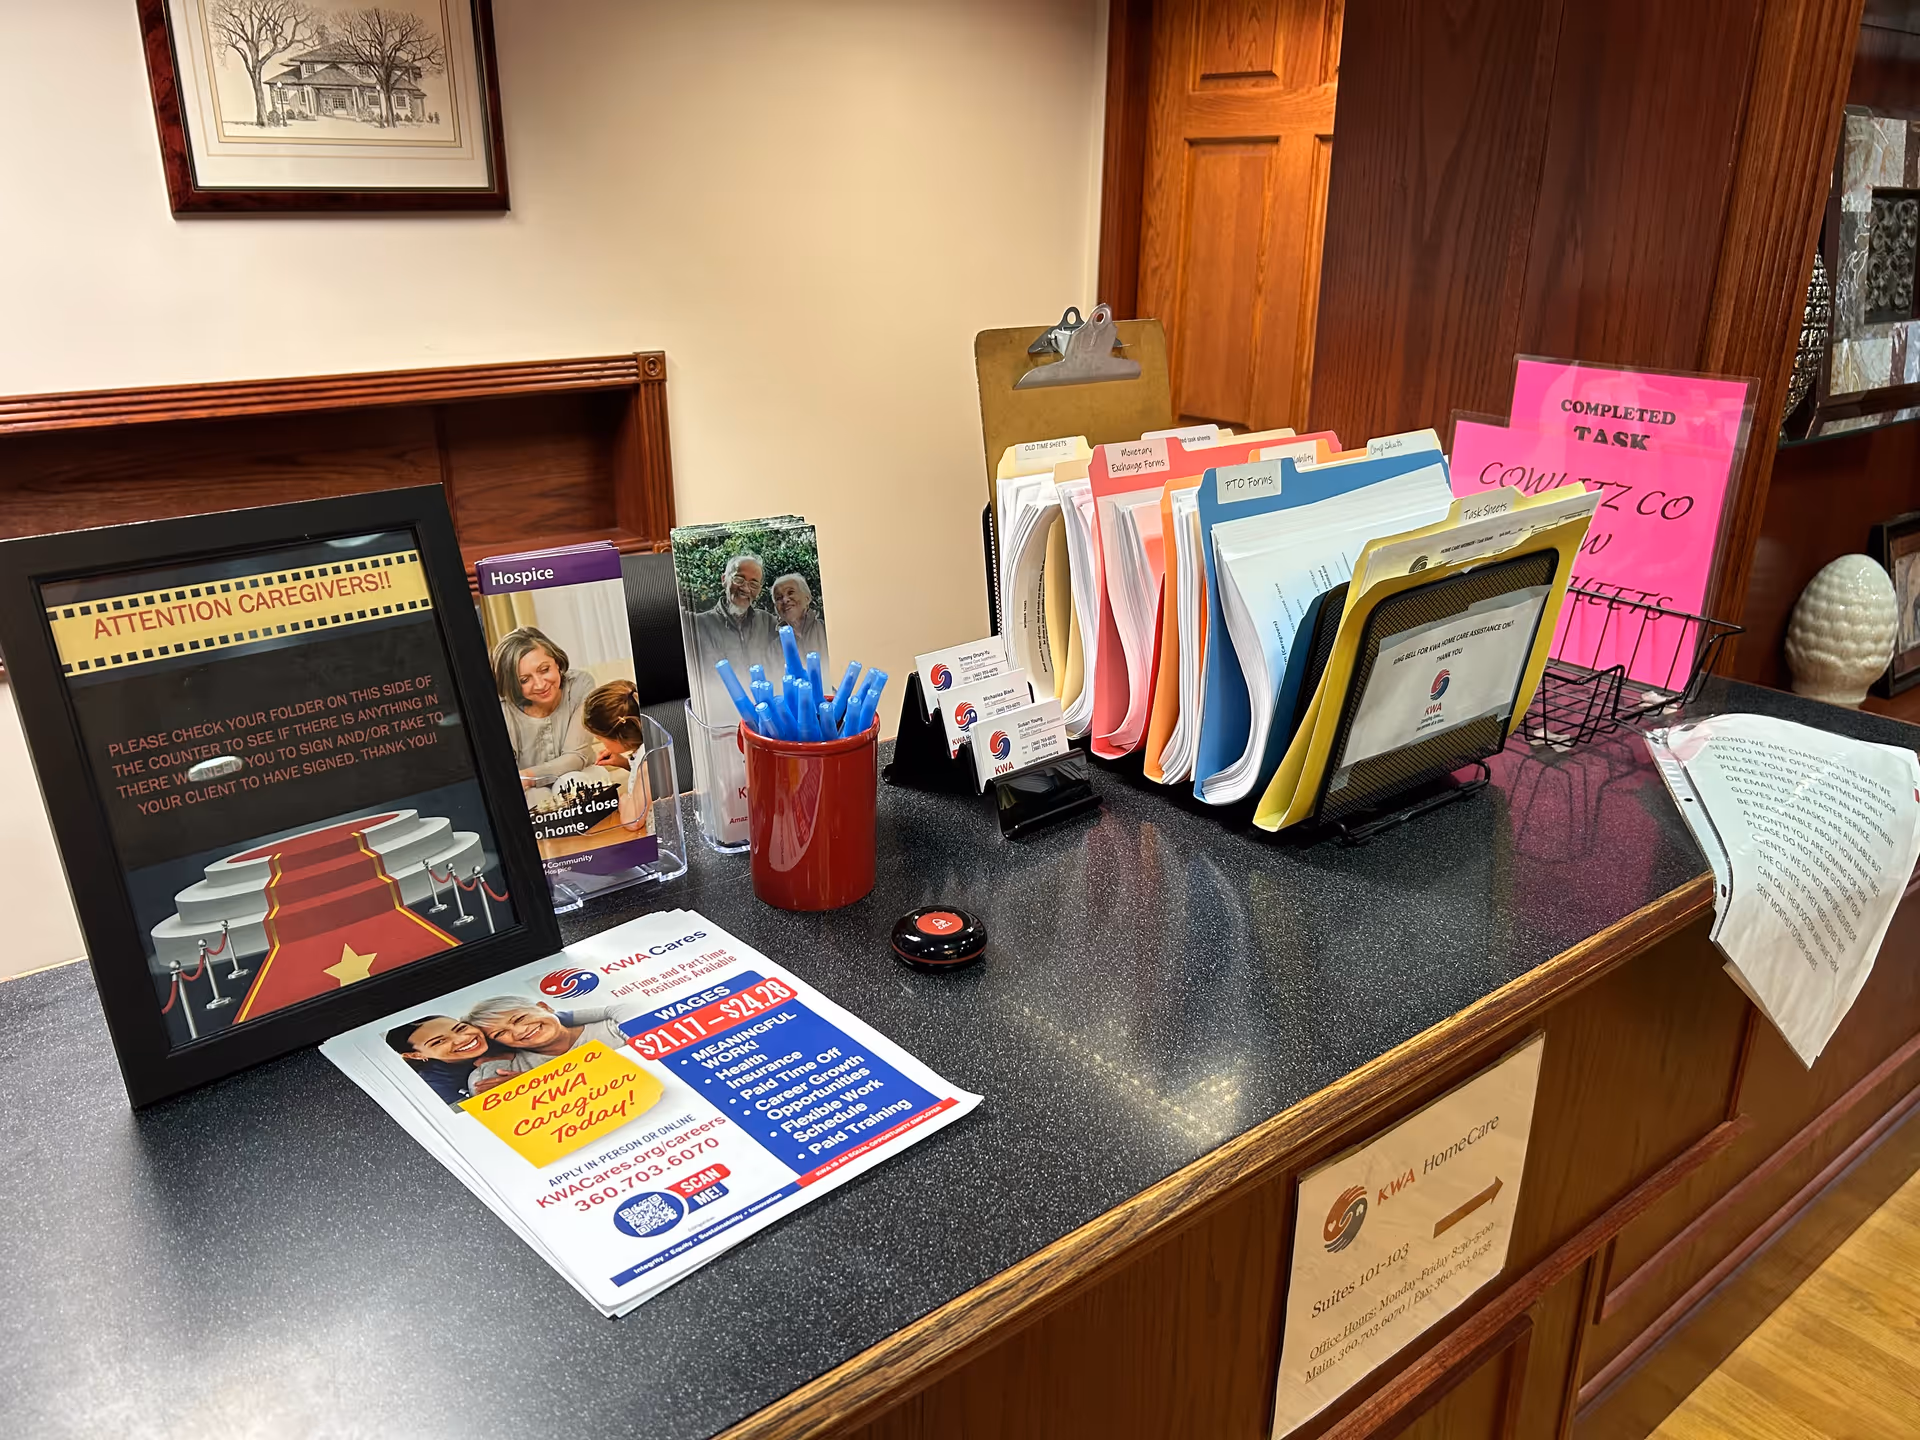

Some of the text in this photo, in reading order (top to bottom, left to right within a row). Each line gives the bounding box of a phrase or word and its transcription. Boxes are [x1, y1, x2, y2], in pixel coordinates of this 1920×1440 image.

[1560, 399, 1677, 425] COMPLETED
[1037, 442, 1049, 450] TIME
[1049, 440, 1067, 448] SHEETS
[1121, 446, 1153, 457] Monetary
[1573, 425, 1651, 451] TASK
[1111, 459, 1165, 473] Exchange Forms
[1225, 474, 1273, 492] PTO Forms
[1479, 462, 1694, 520] COWTZ CO
[1463, 501, 1508, 521] Task Sheets
[491, 566, 554, 586] Hospice
[1569, 575, 1673, 621] HEETS
[93, 571, 392, 640] ATTENTION CAREGIVERS!!
[1405, 651, 1416, 659] BELL
[1417, 646, 1429, 656] FOR
[1429, 643, 1441, 652] KWA
[1441, 636, 1456, 647] HOME
[1456, 631, 1469, 641] CARE
[1469, 624, 1500, 637] ASSISTANCE
[1451, 647, 1463, 656] YOU
[107, 674, 432, 757] PLEASE CHECK YOUR FOLDER ON THIS SIDE OF
[1425, 702, 1442, 716] KWA
[112, 693, 437, 778] THE COUNTER TO SEE IF THERE IS ANYTHING IN
[116, 774, 170, 799] THERE
[202, 760, 243, 778] NEED
[244, 750, 275, 768] YOU
[277, 745, 297, 760] TO
[299, 736, 333, 755] SIGN
[336, 723, 389, 748] AND/OR
[391, 715, 424, 733] TAKE
[426, 710, 443, 725] TO
[137, 731, 437, 816] YOUR CLIENT TO HAVE SIGNED. THANK YOU!
[995, 763, 1014, 775] KWA
[1768, 744, 1787, 753] ARE
[1840, 765, 1858, 779] THE
[1859, 774, 1878, 789] WAY
[1879, 784, 1892, 798] WE
[535, 822, 588, 839] o home.
[585, 799, 618, 813] close
[1731, 786, 1882, 874] GLOVES MASKS ARE AVAILABLE BUT
[547, 855, 593, 868] Community
[1752, 812, 1790, 832] MONTH
[1791, 827, 1809, 843] YOU
[1810, 840, 1824, 854] ARE
[1824, 850, 1848, 878] COMING
[545, 866, 571, 875] Hospice
[611, 948, 727, 997] Full-Time and Part-Time
[642, 954, 737, 997] Positions Available
[633, 980, 790, 1058] $21.17 $24.28
[654, 985, 730, 1021] WAGES
[689, 1009, 798, 1061] MEANINGFUL
[700, 1039, 760, 1070] WORK!
[482, 1051, 602, 1111] Become a
[531, 1072, 588, 1110] KWA
[714, 1051, 769, 1081] Health
[725, 1049, 804, 1090] Insurance
[738, 1046, 844, 1101] Paid Time Off
[752, 1053, 865, 1112] Career Growth
[513, 1074, 636, 1136] Caregiver
[550, 1090, 635, 1143] Today!
[764, 1064, 872, 1123] Opportunities
[779, 1076, 884, 1134] Flexible Work
[791, 1099, 869, 1144] Schedule
[807, 1096, 913, 1155] Paid Training
[536, 1115, 726, 1209] KWACares.org/careers
[549, 1113, 696, 1187] APPLY IN-PERSON OR ONLINE
[574, 1137, 719, 1212] 360.703.6070
[1377, 1114, 1500, 1206] KWA HomeCare
[680, 1168, 721, 1194] SCAN
[693, 1185, 723, 1206] ME!
[633, 1255, 664, 1274] Integrity
[670, 1241, 693, 1255] Equity
[699, 1214, 744, 1239] Sustainability
[1311, 1243, 1409, 1319] Suites 101-103
[1305, 1355, 1336, 1384] Main:
[1338, 1303, 1405, 1361] 360.703.6070
[1309, 1333, 1341, 1361] Office
[1343, 1308, 1377, 1339] Hours:
